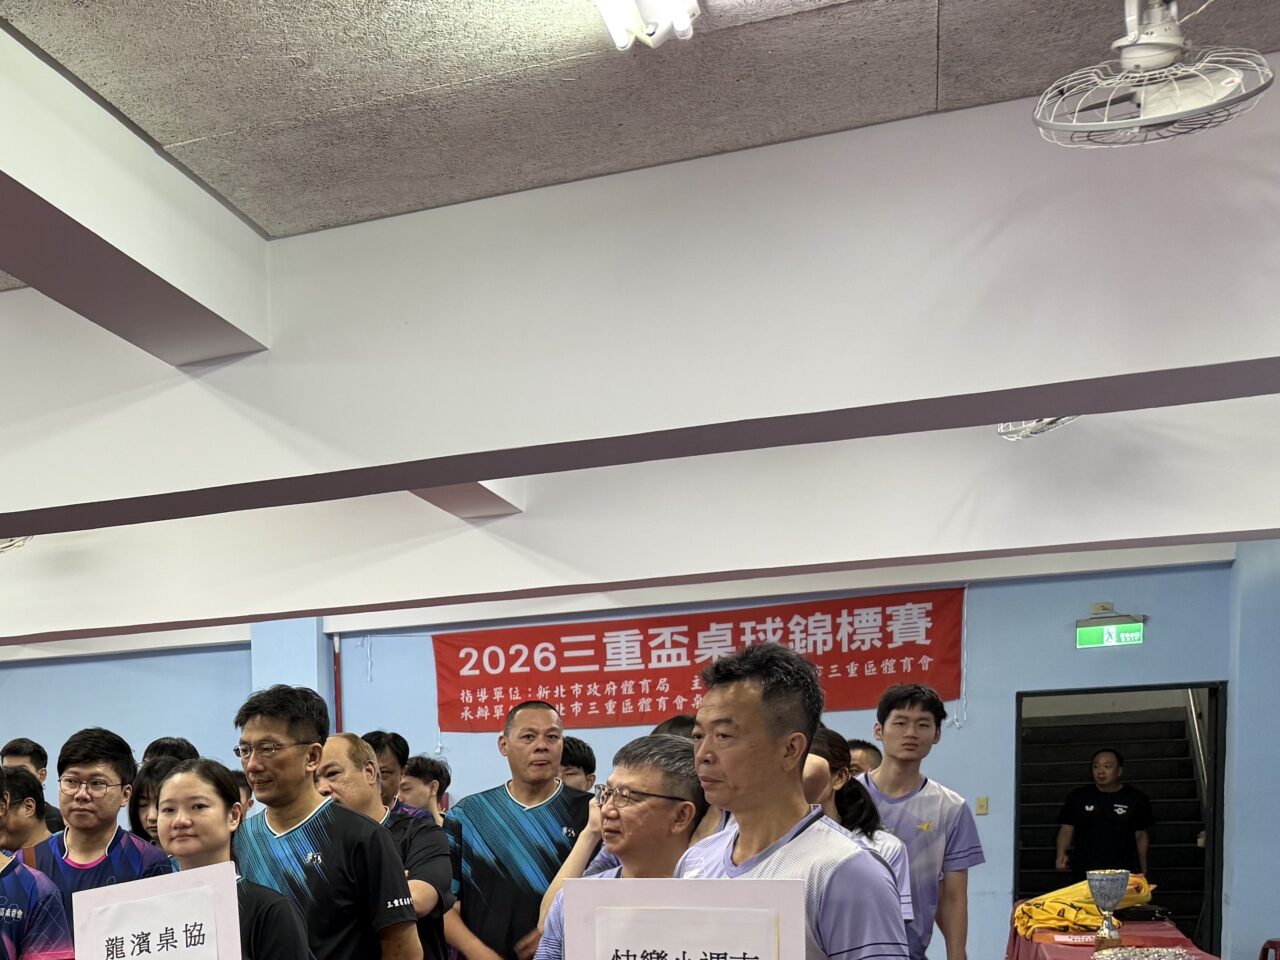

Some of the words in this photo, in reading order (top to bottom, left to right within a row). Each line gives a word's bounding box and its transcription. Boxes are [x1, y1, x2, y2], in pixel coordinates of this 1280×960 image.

[458, 601, 934, 677] 2026三重盃桌球錦標賽
